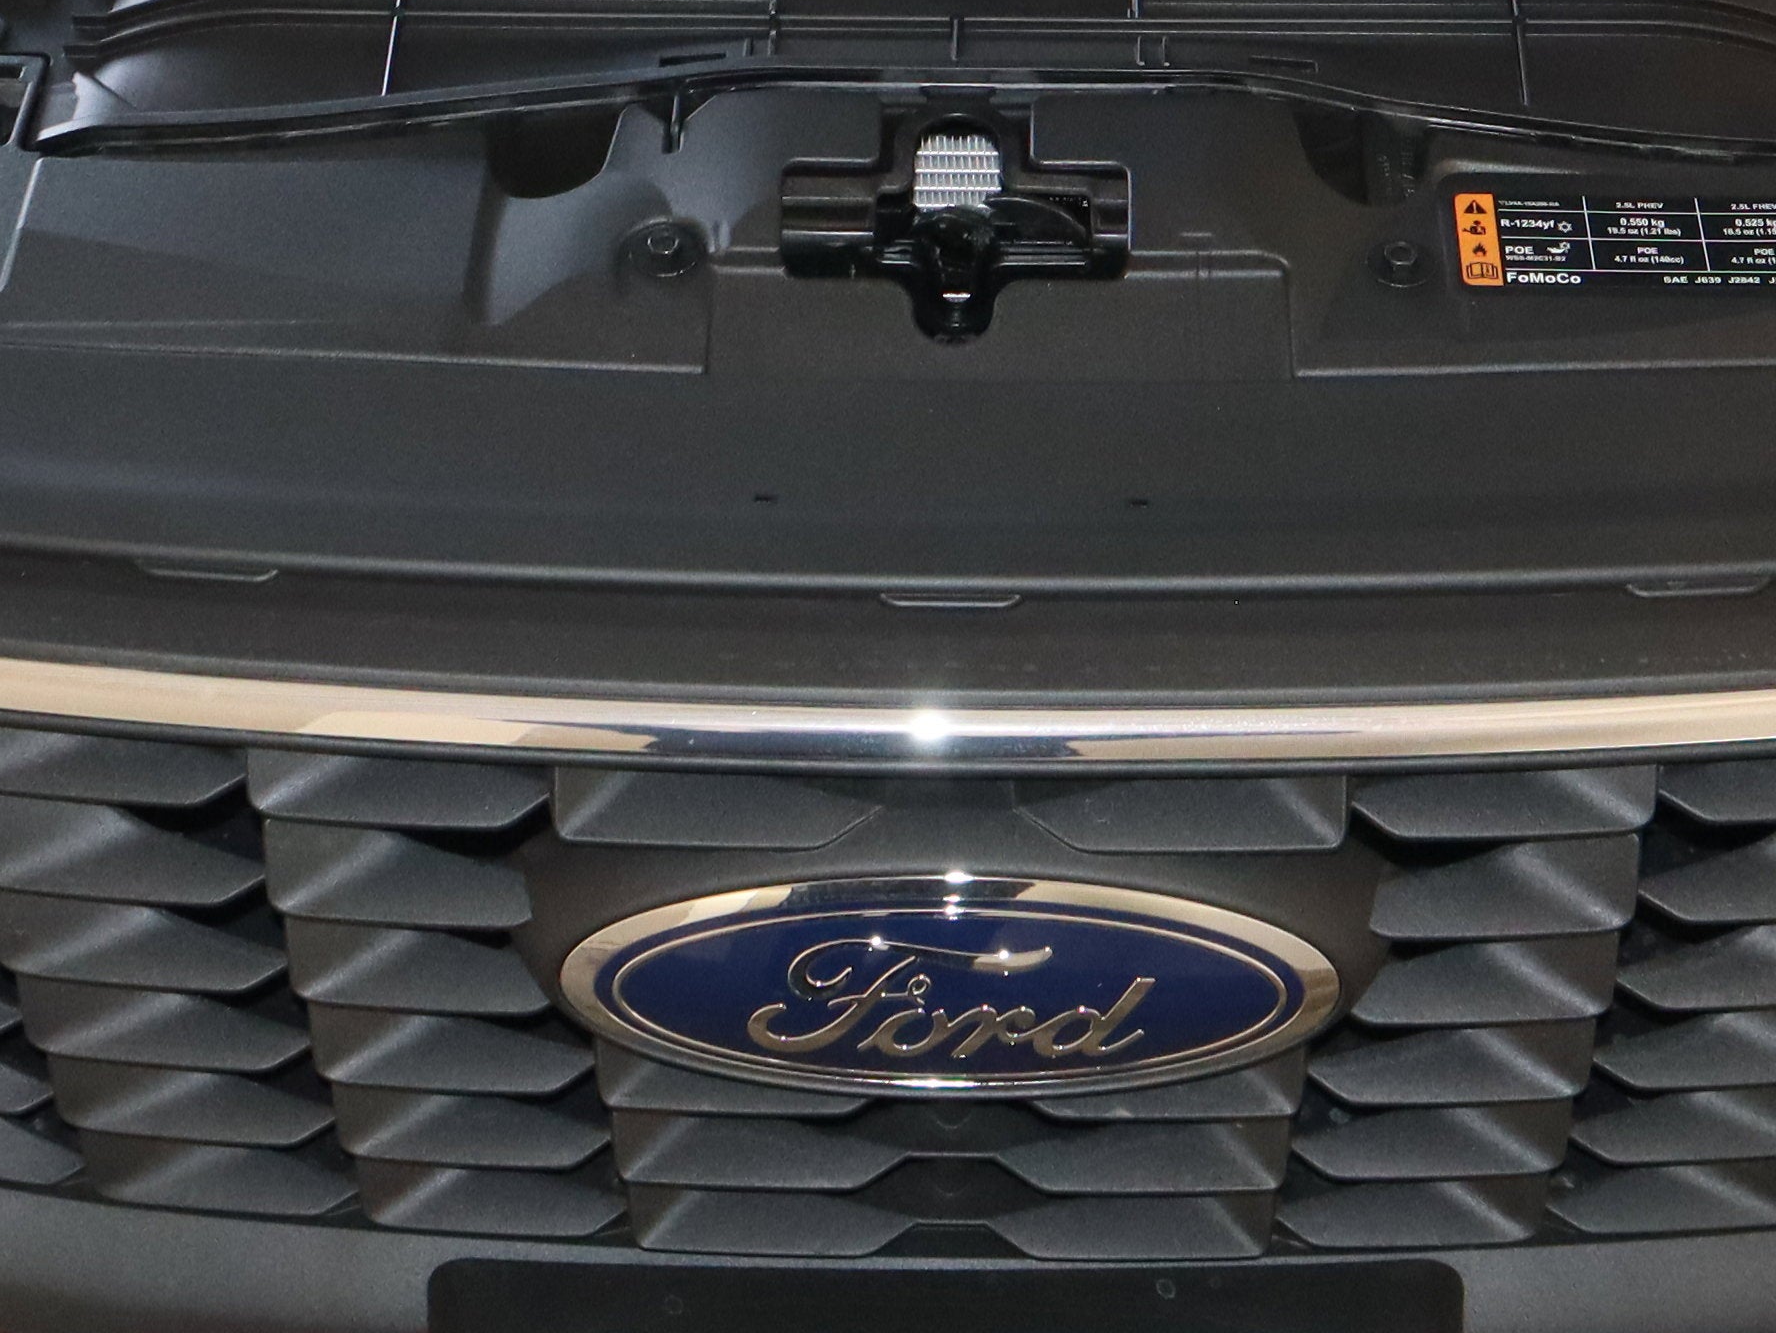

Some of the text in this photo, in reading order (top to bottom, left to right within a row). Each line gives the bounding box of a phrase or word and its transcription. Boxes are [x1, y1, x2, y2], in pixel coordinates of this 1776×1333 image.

[1500, 218, 1555, 231] R-1234yf
[1619, 217, 1665, 229] 0.550 kg
[1735, 218, 1764, 228] 0.525
[1505, 245, 1534, 255] POE
[1637, 246, 1658, 254] POE
[1506, 271, 1581, 284] FoMoCo
[1664, 276, 1688, 284] SAE
[748, 936, 1156, 1059] Ford
